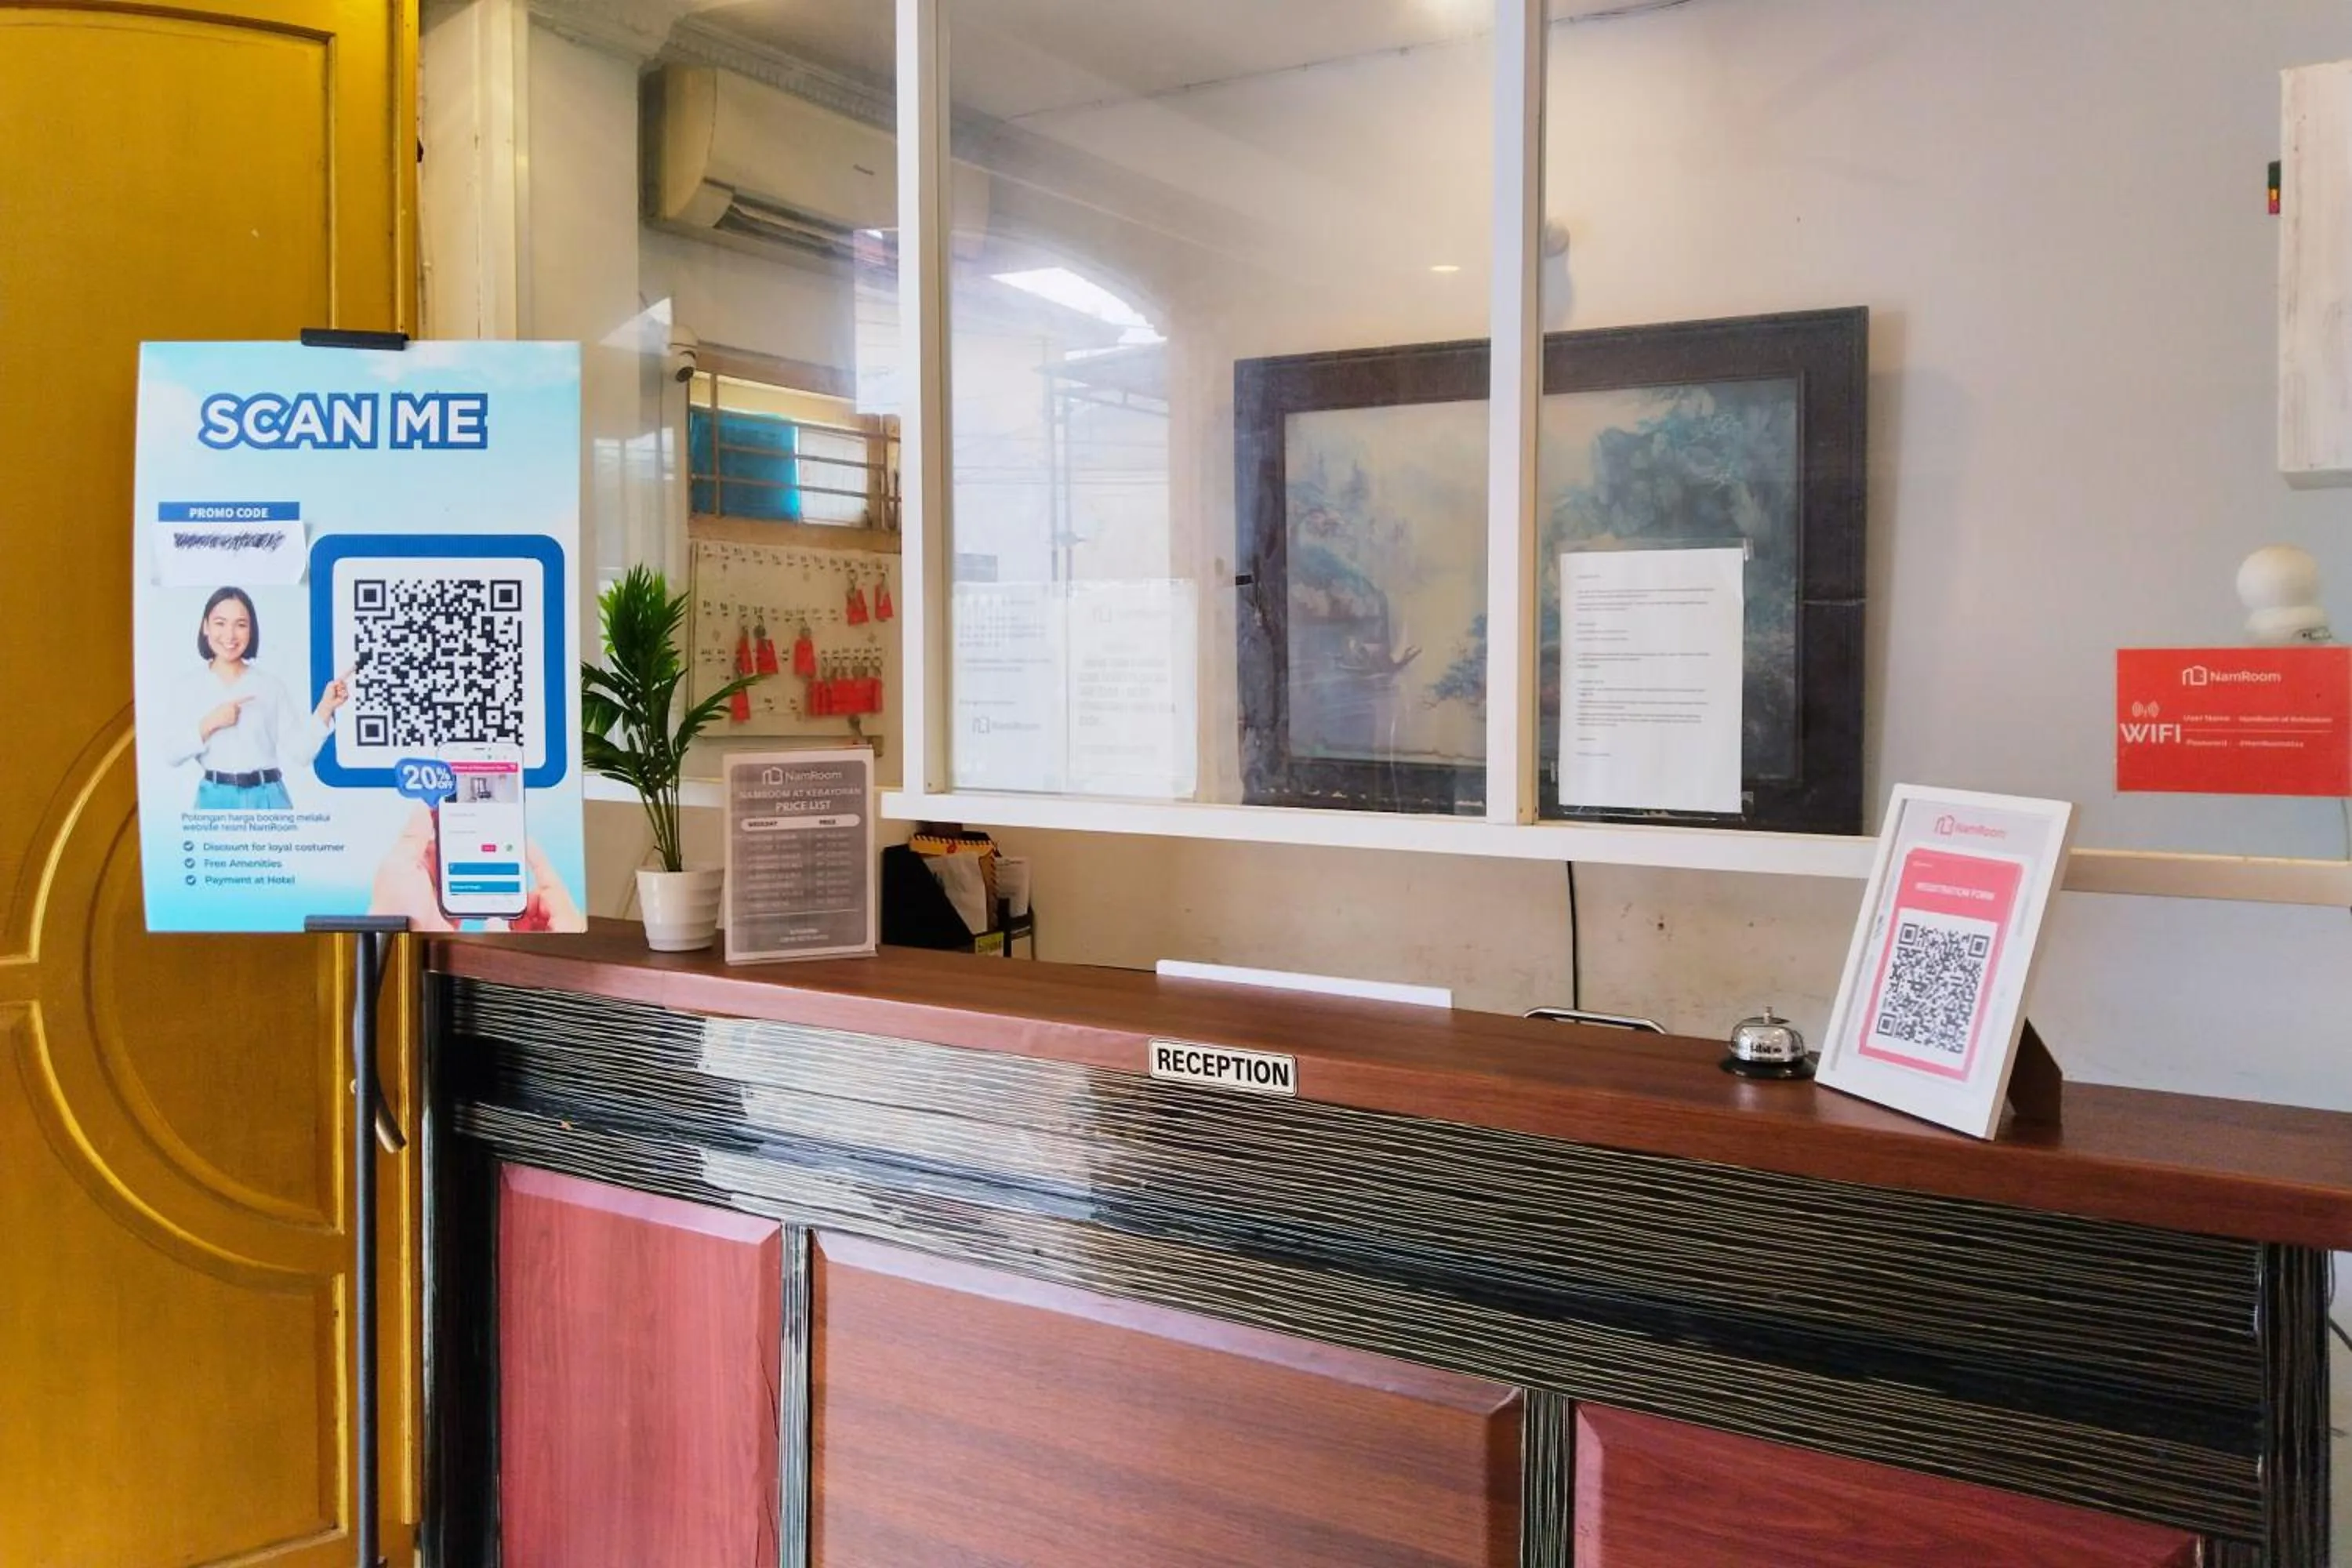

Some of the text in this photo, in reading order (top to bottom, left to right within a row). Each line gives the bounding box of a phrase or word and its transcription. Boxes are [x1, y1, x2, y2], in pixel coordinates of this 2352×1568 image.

[198, 392, 488, 449] SCAN ME
[189, 507, 269, 517] PROMO CODE
[2210, 671, 2281, 683] NamRoom
[2120, 723, 2182, 744] WIFI
[403, 765, 451, 789] 20%
[785, 771, 842, 782] NamRoom
[775, 800, 832, 812] PRICE LIST
[228, 813, 254, 823] harga
[256, 813, 295, 823] booking
[203, 843, 249, 851] Discount
[252, 842, 266, 851] for
[269, 842, 292, 853] loyal
[229, 858, 282, 868] Amenities
[205, 876, 252, 885] Payment
[267, 876, 295, 884] Hotel
[1156, 1047, 1290, 1087] RECEPTION
